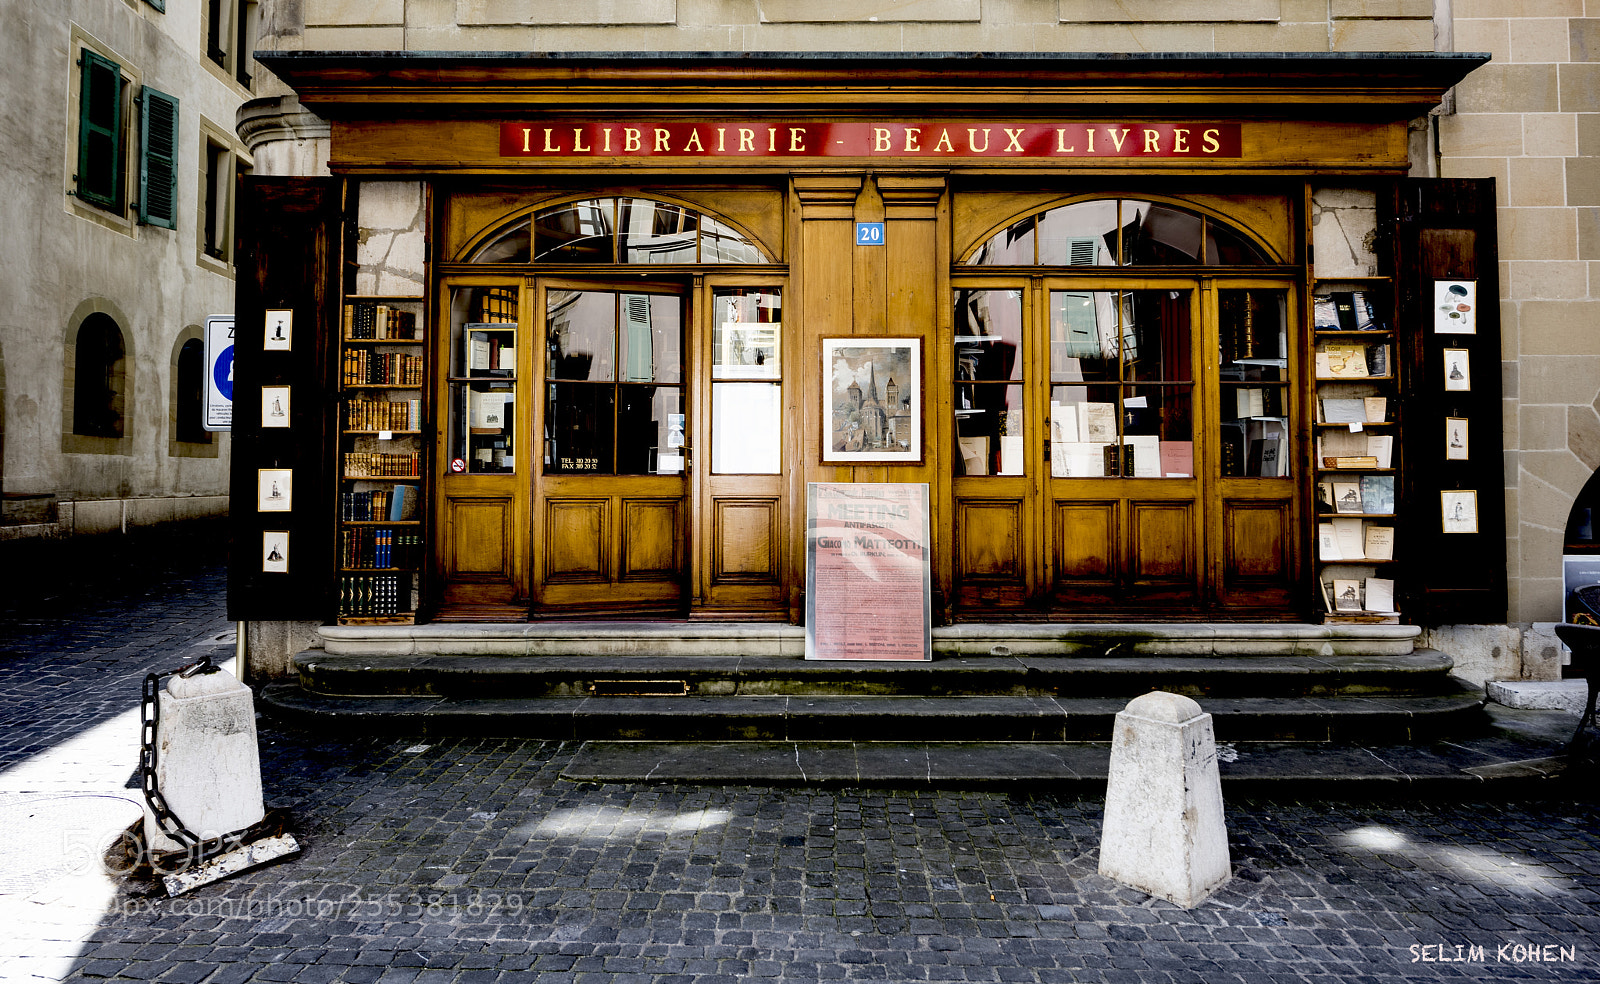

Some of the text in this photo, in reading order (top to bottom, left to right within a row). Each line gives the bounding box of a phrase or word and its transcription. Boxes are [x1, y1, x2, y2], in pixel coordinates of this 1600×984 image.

[522, 127, 806, 152] ILLIBRAIRIE
[873, 127, 1025, 153] BEAUX
[1056, 128, 1220, 153] LIVRES
[861, 227, 880, 242] 20
[827, 504, 909, 520] MEETING
